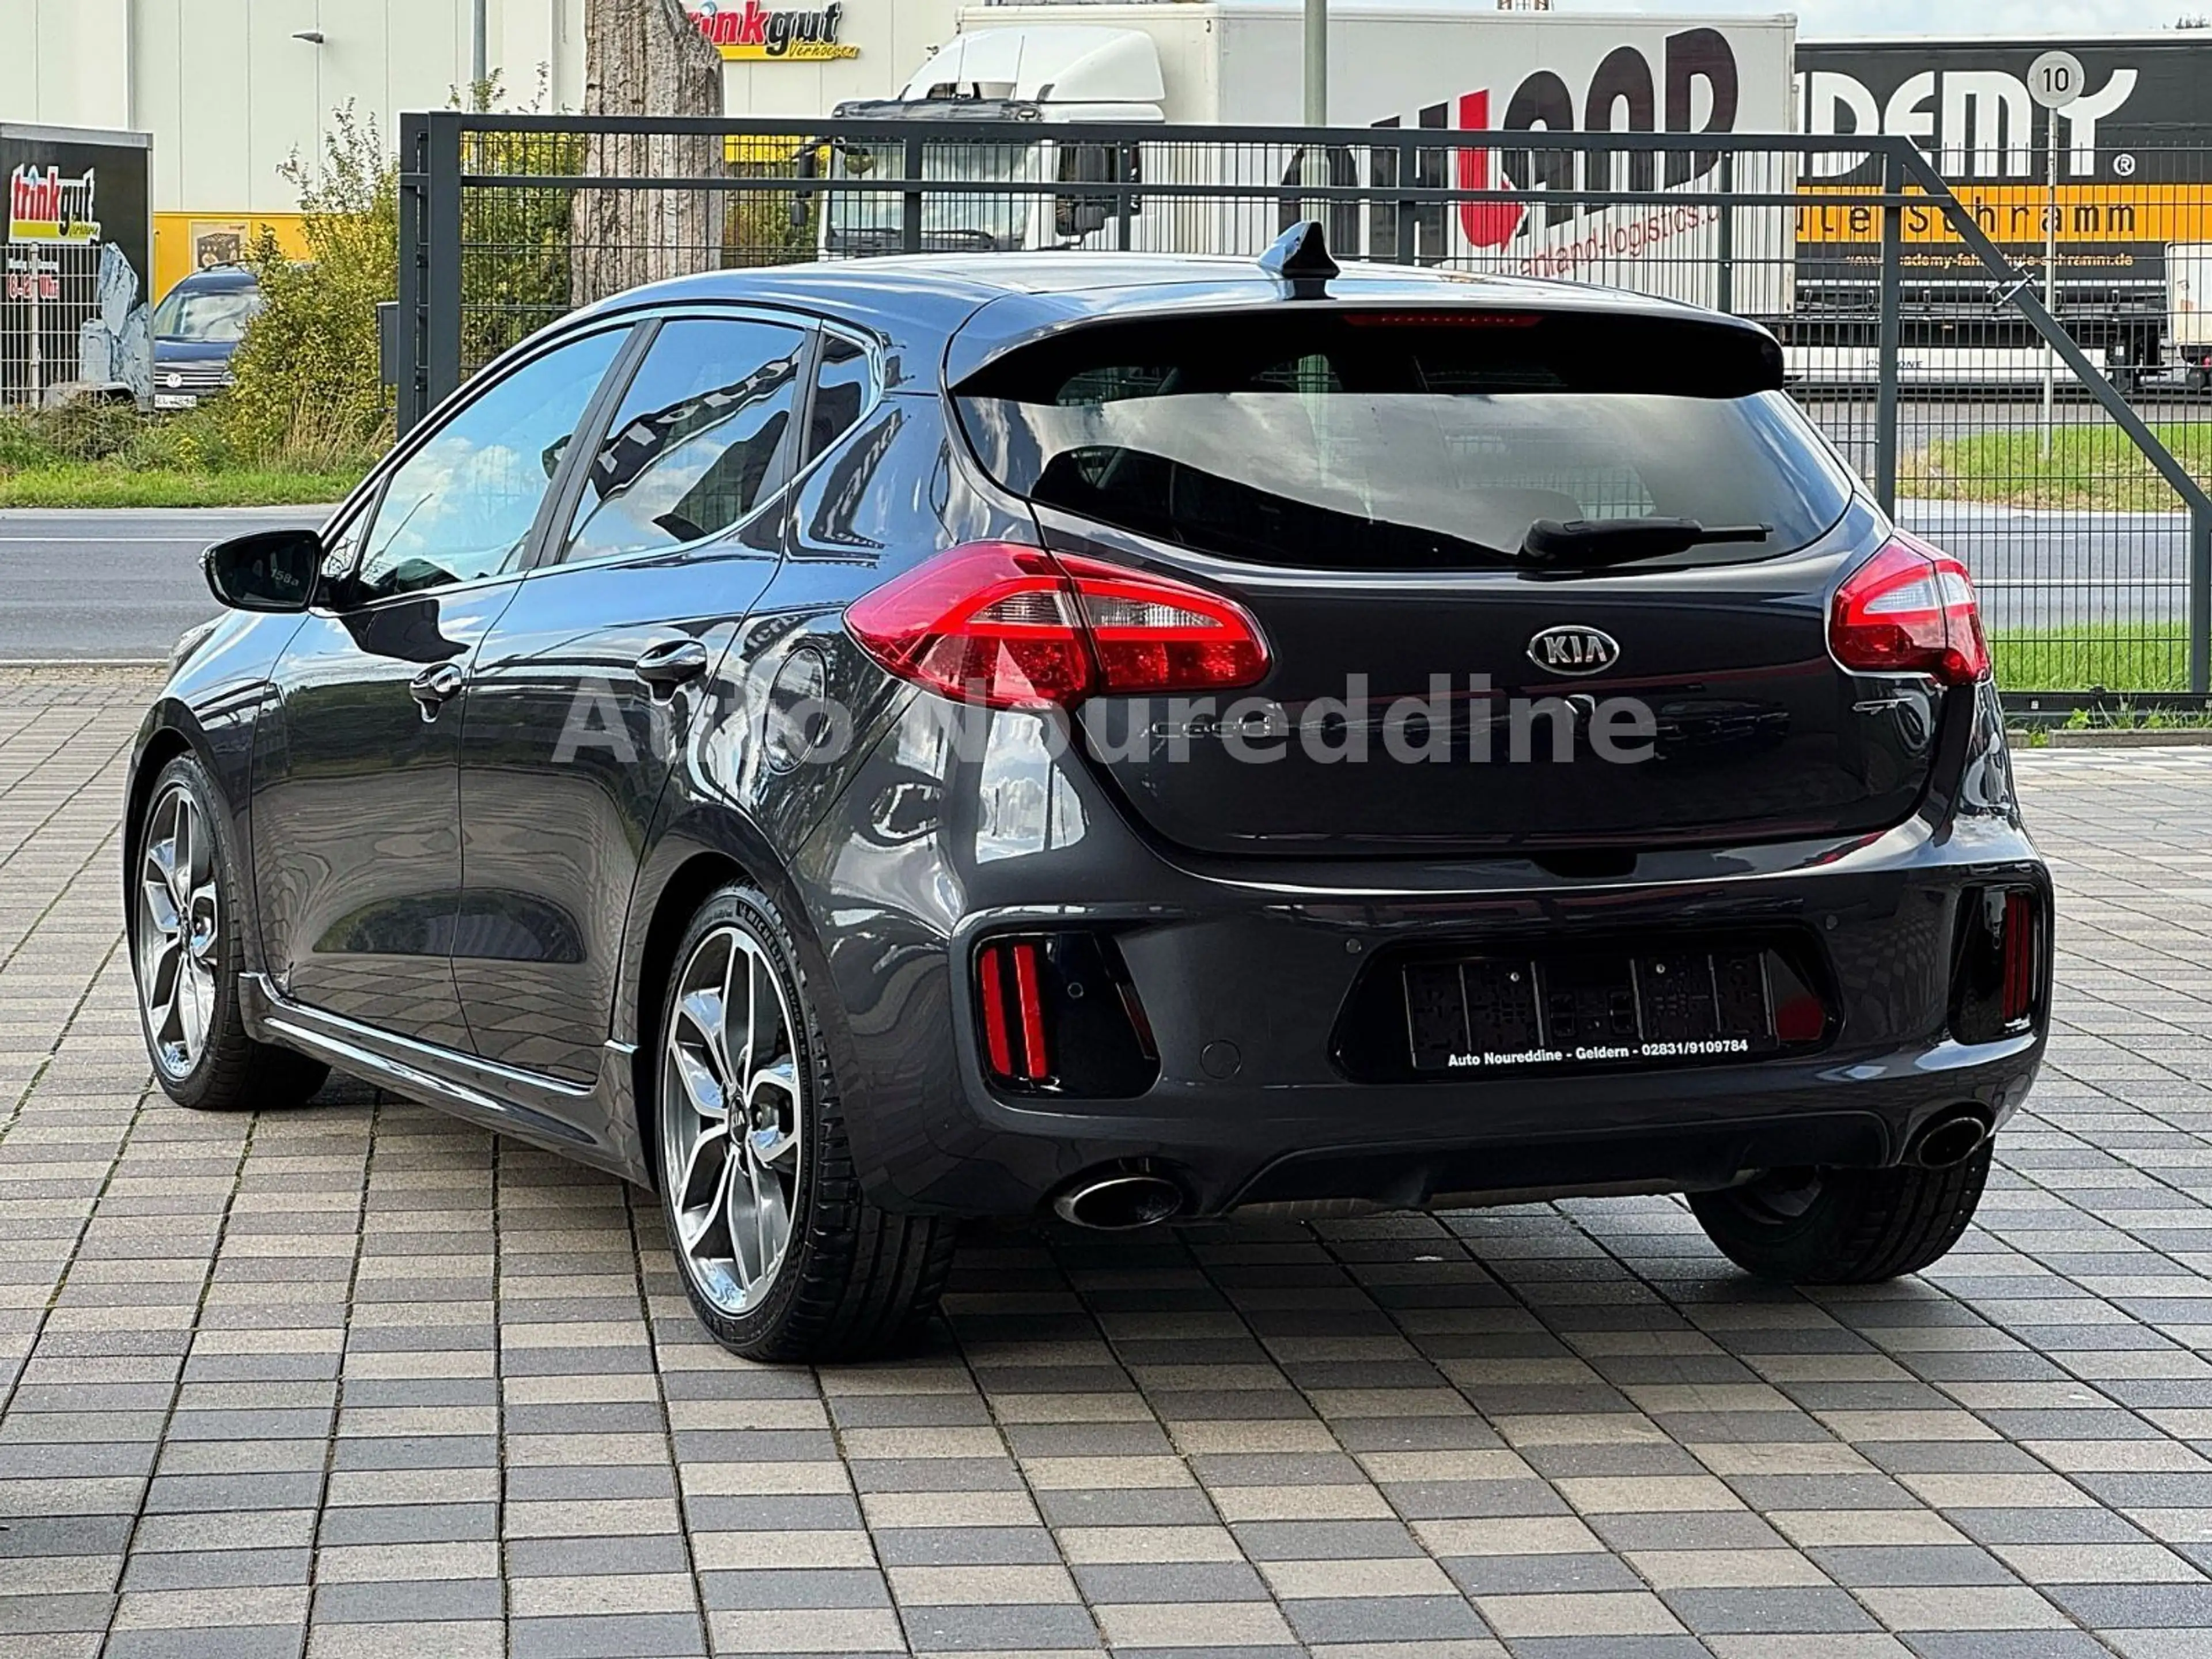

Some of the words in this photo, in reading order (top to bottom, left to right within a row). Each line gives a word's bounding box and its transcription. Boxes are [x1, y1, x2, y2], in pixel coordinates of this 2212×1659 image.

[2043, 67, 2069, 92] 10
[1795, 69, 2138, 177] DEMY
[14, 172, 91, 236] trinkgut
[1544, 636, 1607, 663] KIA
[747, 910, 788, 974] MICHELIN
[1448, 1053, 1480, 1066] Auto
[1484, 1049, 1563, 1065] Noureddine
[1575, 1046, 1630, 1060] Geldern
[1642, 1039, 1748, 1056] 02831/9109784
